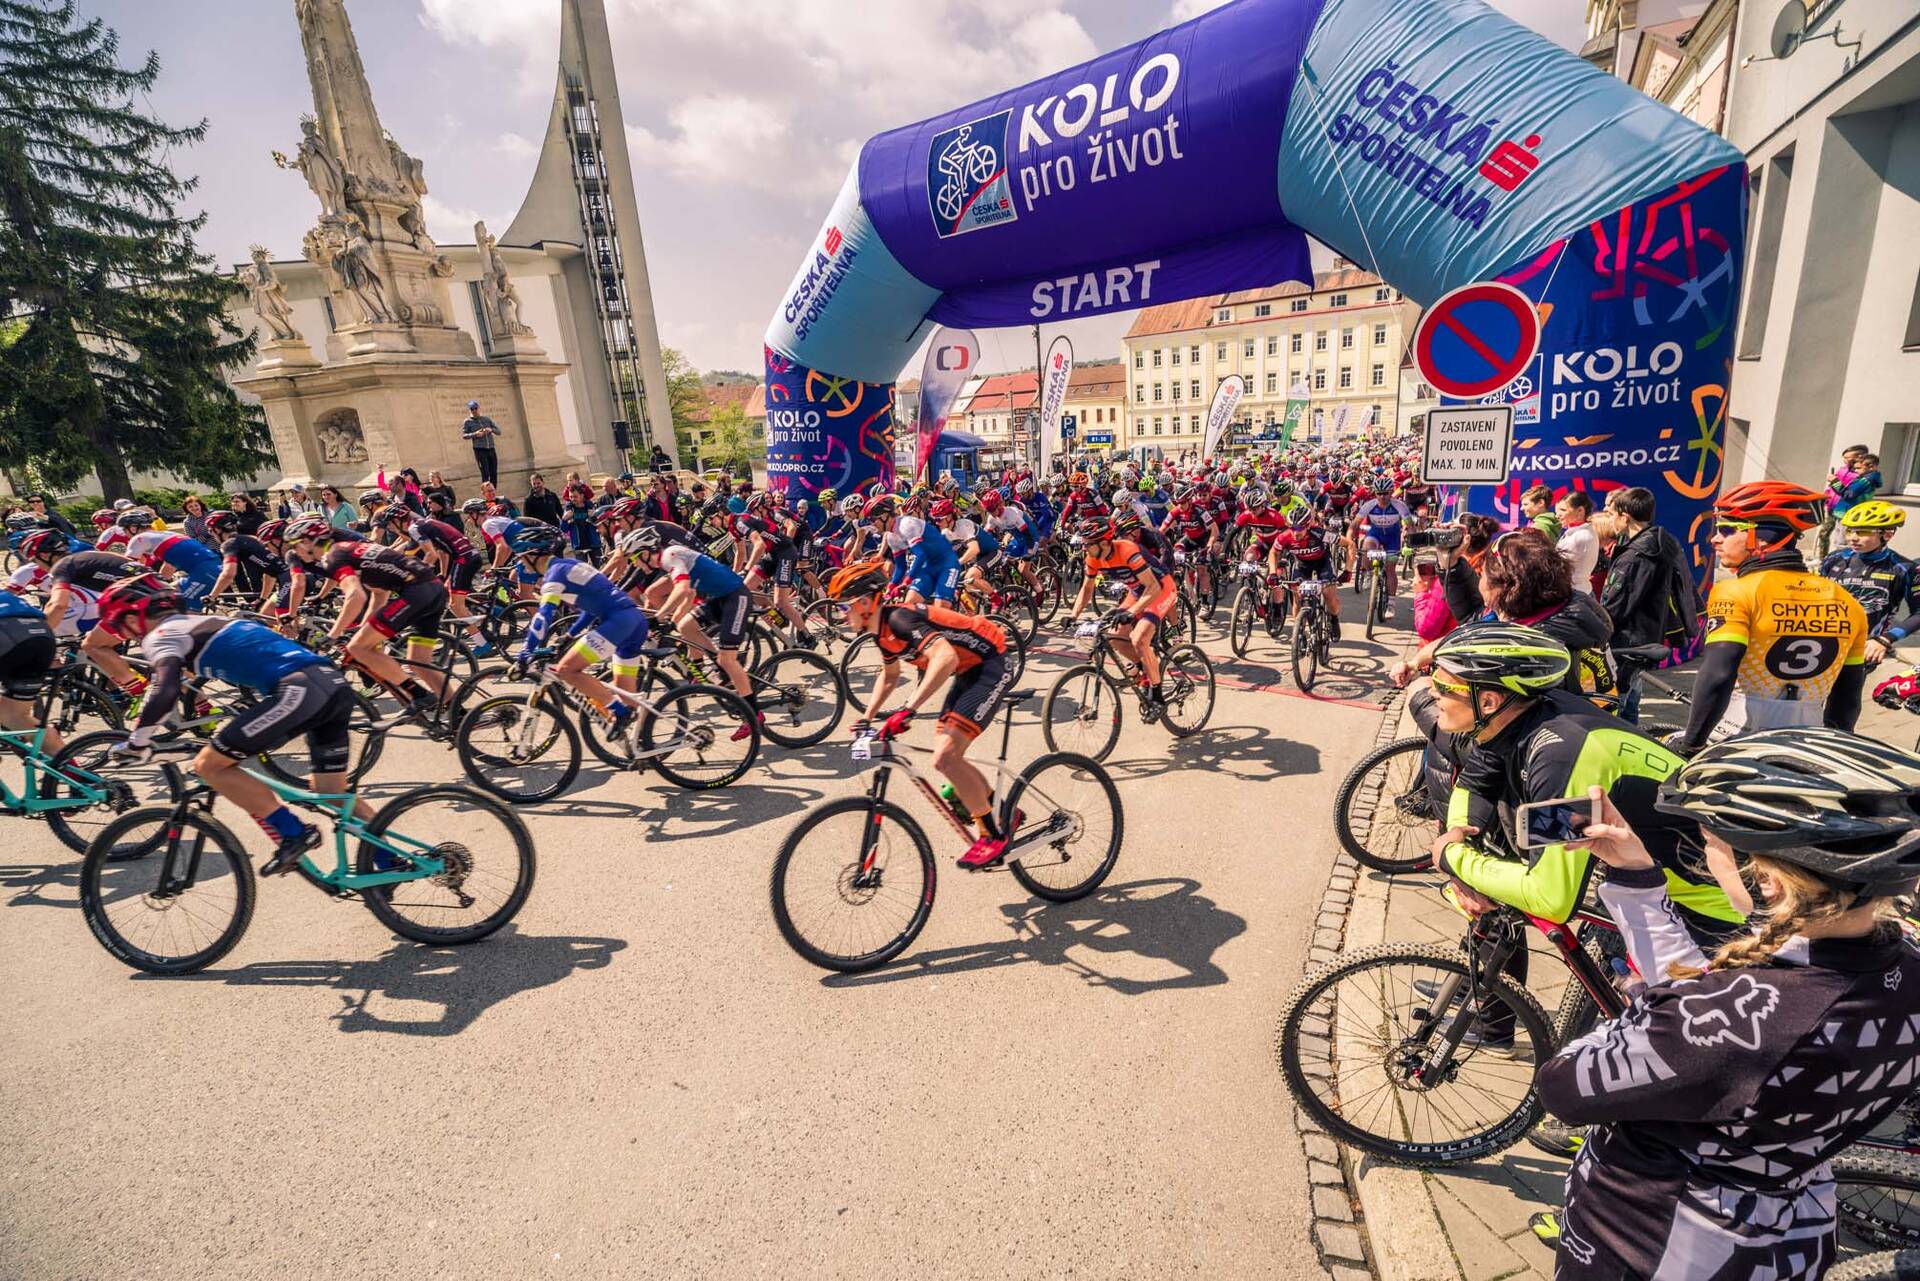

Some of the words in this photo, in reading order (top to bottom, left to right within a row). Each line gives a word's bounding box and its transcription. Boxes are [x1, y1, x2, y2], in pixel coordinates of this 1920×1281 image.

[1019, 53, 1180, 153] KOLO
[1355, 59, 1500, 169] ČESKÁ
[1020, 155, 1076, 212] pro
[1087, 113, 1183, 184] život
[1328, 114, 1492, 231] SPOŘITELNA
[785, 250, 830, 324] ČESKÁ
[1030, 259, 1161, 318] START
[1552, 341, 1683, 386] KOLO
[1551, 391, 1599, 419] pro
[1611, 377, 1681, 408] život
[773, 410, 820, 428] KOLO
[1063, 416, 1073, 429] P
[1440, 417, 1498, 433] ZASTAVENÍ
[774, 430, 789, 445] pro
[791, 427, 821, 442] život
[1440, 440, 1493, 451] POVOLENO
[1431, 458, 1456, 470] MAX.
[1462, 458, 1472, 470] 10
[1475, 458, 1499, 470] MIN.
[1509, 445, 1682, 472] W.KOLOPRO.CZ
[1771, 600, 1849, 618] CHYTRÝ
[1773, 616, 1851, 634] TRASÉR
[1778, 639, 1823, 675] 3
[1618, 742, 1669, 774] FO
[1396, 1138, 1482, 1153] TUBULAR
[1842, 1203, 1920, 1238] UBULA
